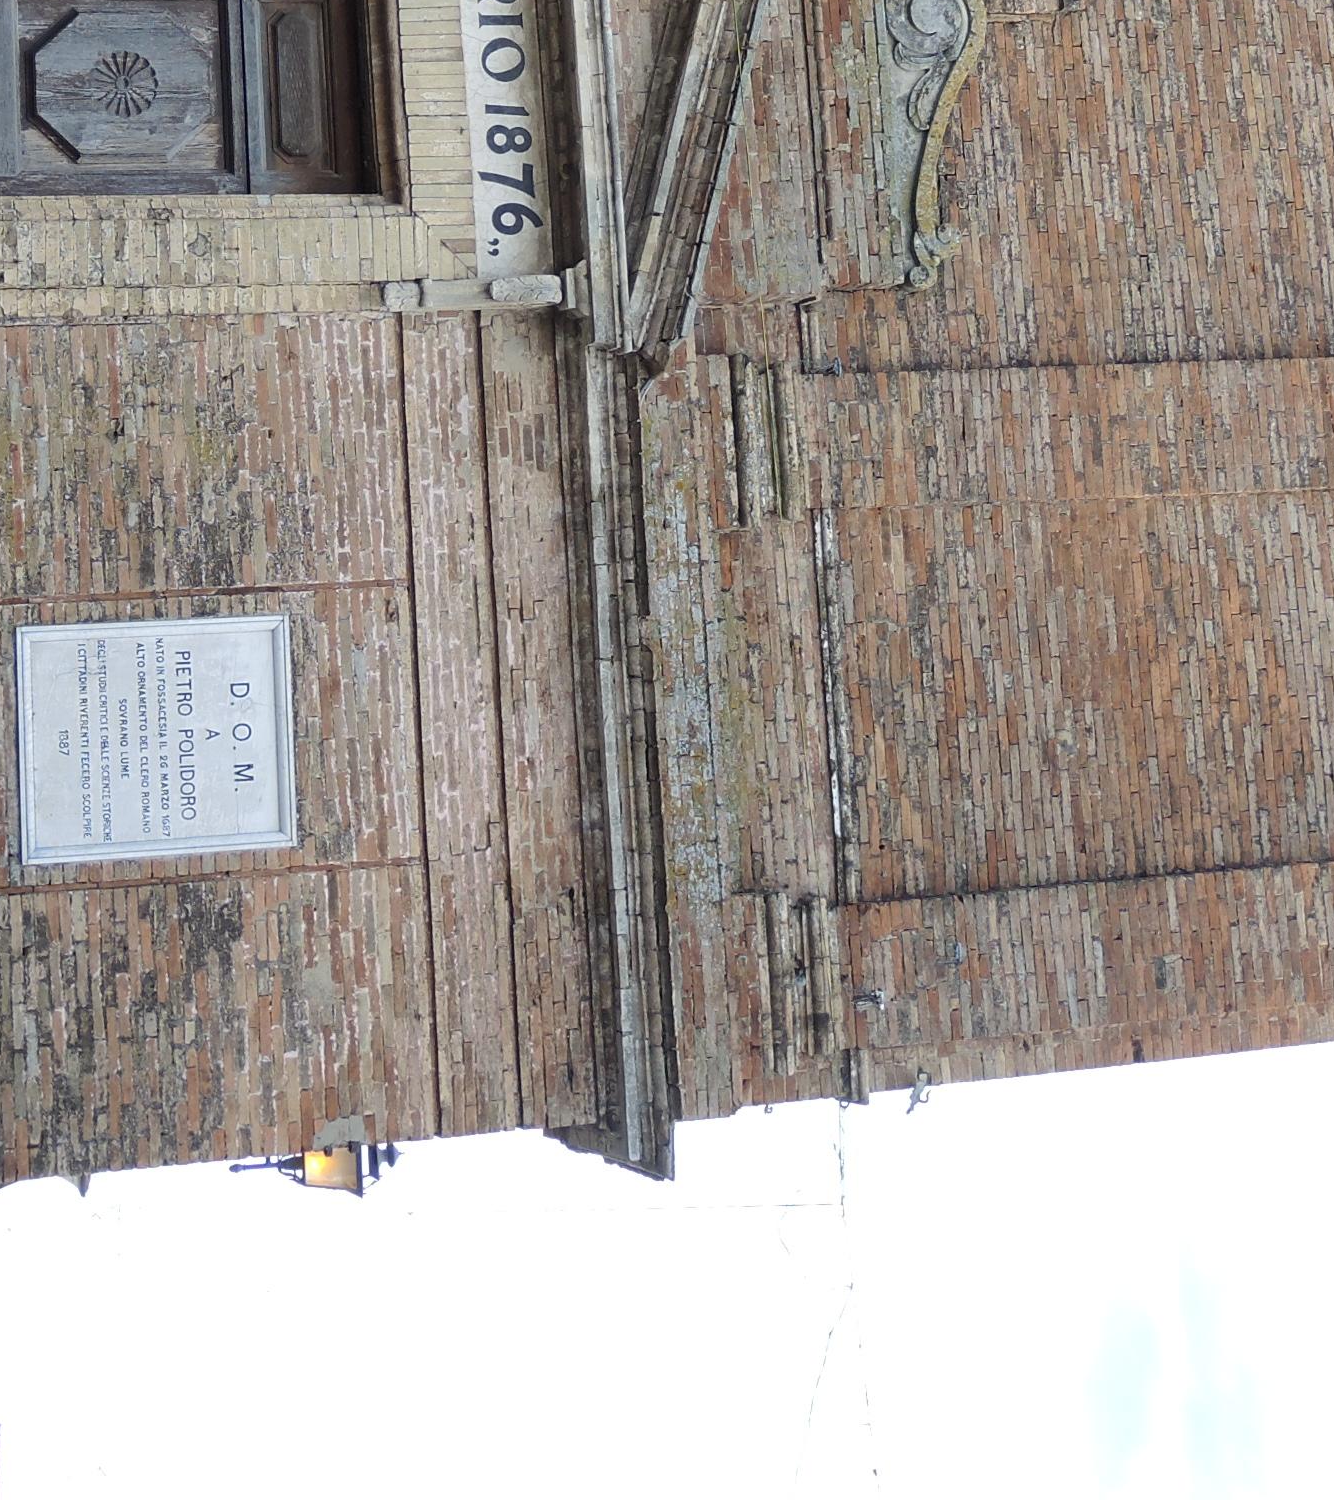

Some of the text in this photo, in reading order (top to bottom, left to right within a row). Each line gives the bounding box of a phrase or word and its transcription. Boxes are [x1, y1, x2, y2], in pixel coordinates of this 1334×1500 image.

[155, 638, 165, 663] NATO
[78, 648, 88, 694] CITTADINI
[156, 666, 165, 675] IN
[79, 698, 89, 747] RIVERENTI
[157, 678, 166, 738] FOSSACESIA
[58, 729, 69, 756] 1887
[119, 698, 130, 780] SOVRANO LUME
[136, 643, 151, 834] ALTO ORNAMENTO DEL CLERO ROMANO
[175, 651, 196, 820] PIETRO POLIDORO
[205, 729, 220, 740] A
[81, 751, 91, 789] FECERO
[159, 755, 169, 768] 26
[101, 765, 111, 800] SCIENZE
[160, 773, 169, 810] MARZO
[82, 794, 92, 838] SCOLPIRE
